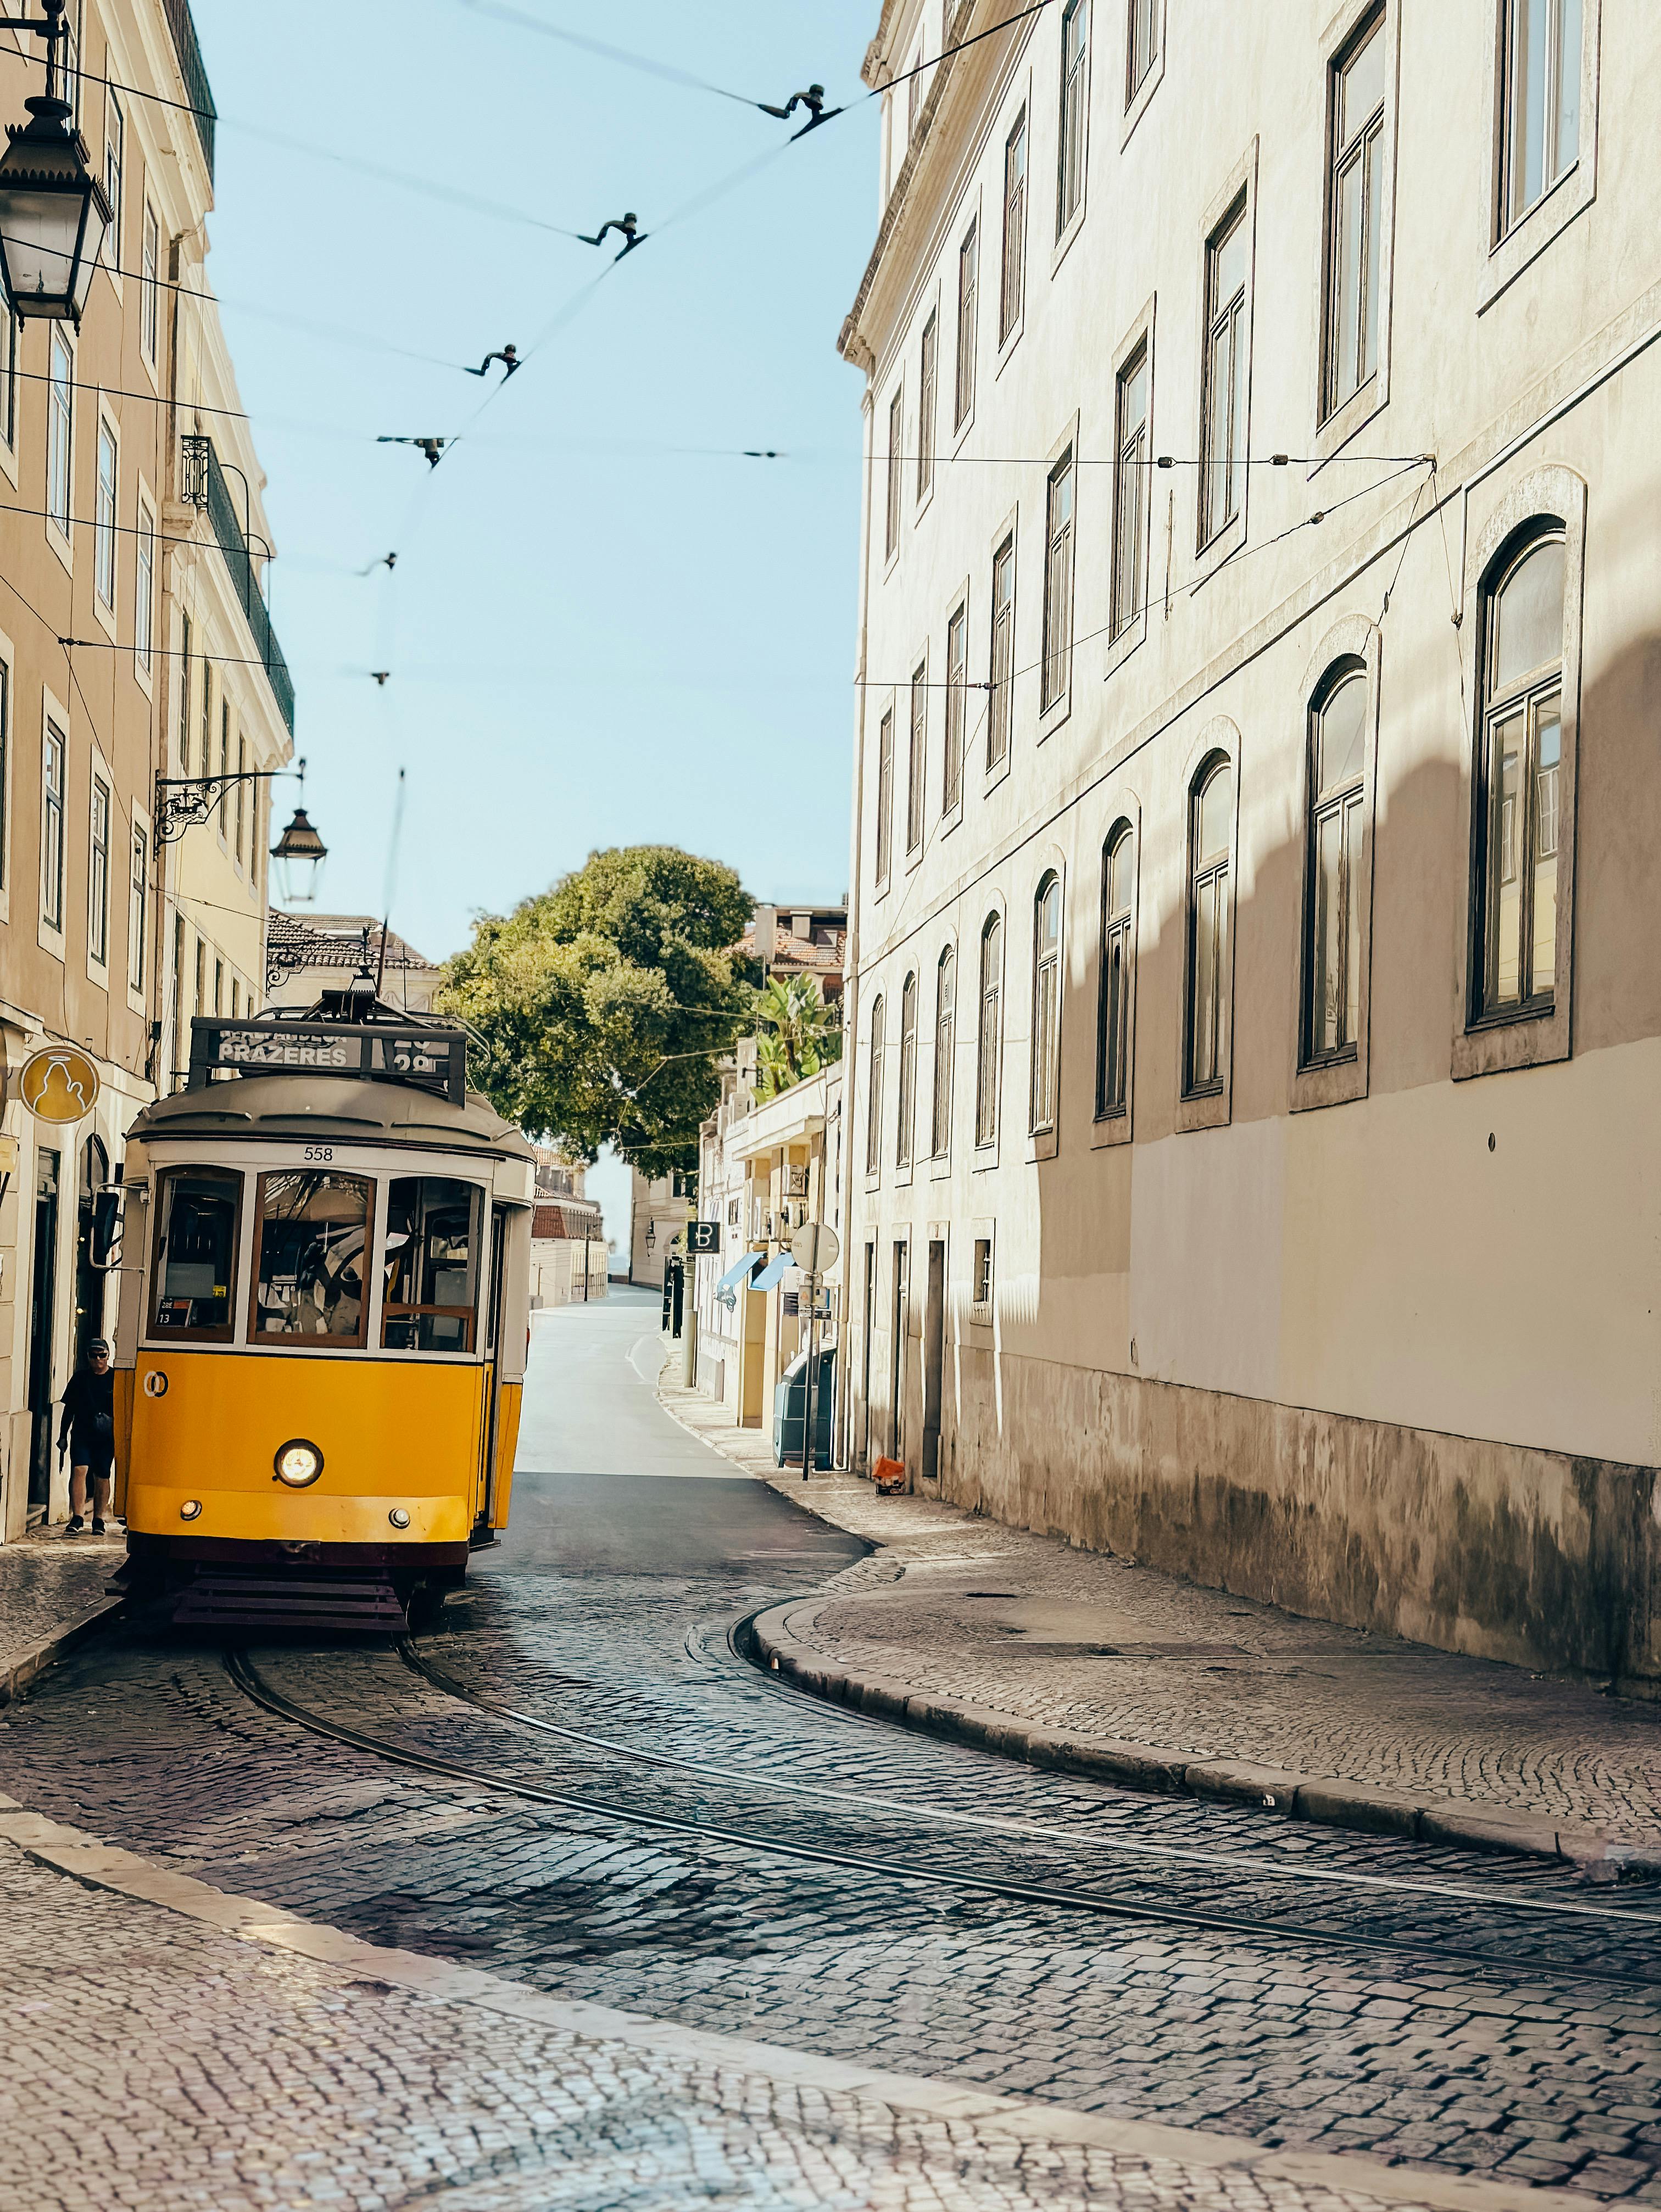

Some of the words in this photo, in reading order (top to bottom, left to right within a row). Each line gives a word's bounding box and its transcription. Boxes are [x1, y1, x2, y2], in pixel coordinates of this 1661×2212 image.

[219, 1043, 347, 1067] PRAZERES
[304, 1147, 333, 1161] 558
[696, 1224, 712, 1247] B
[160, 1314, 170, 1323] 13
